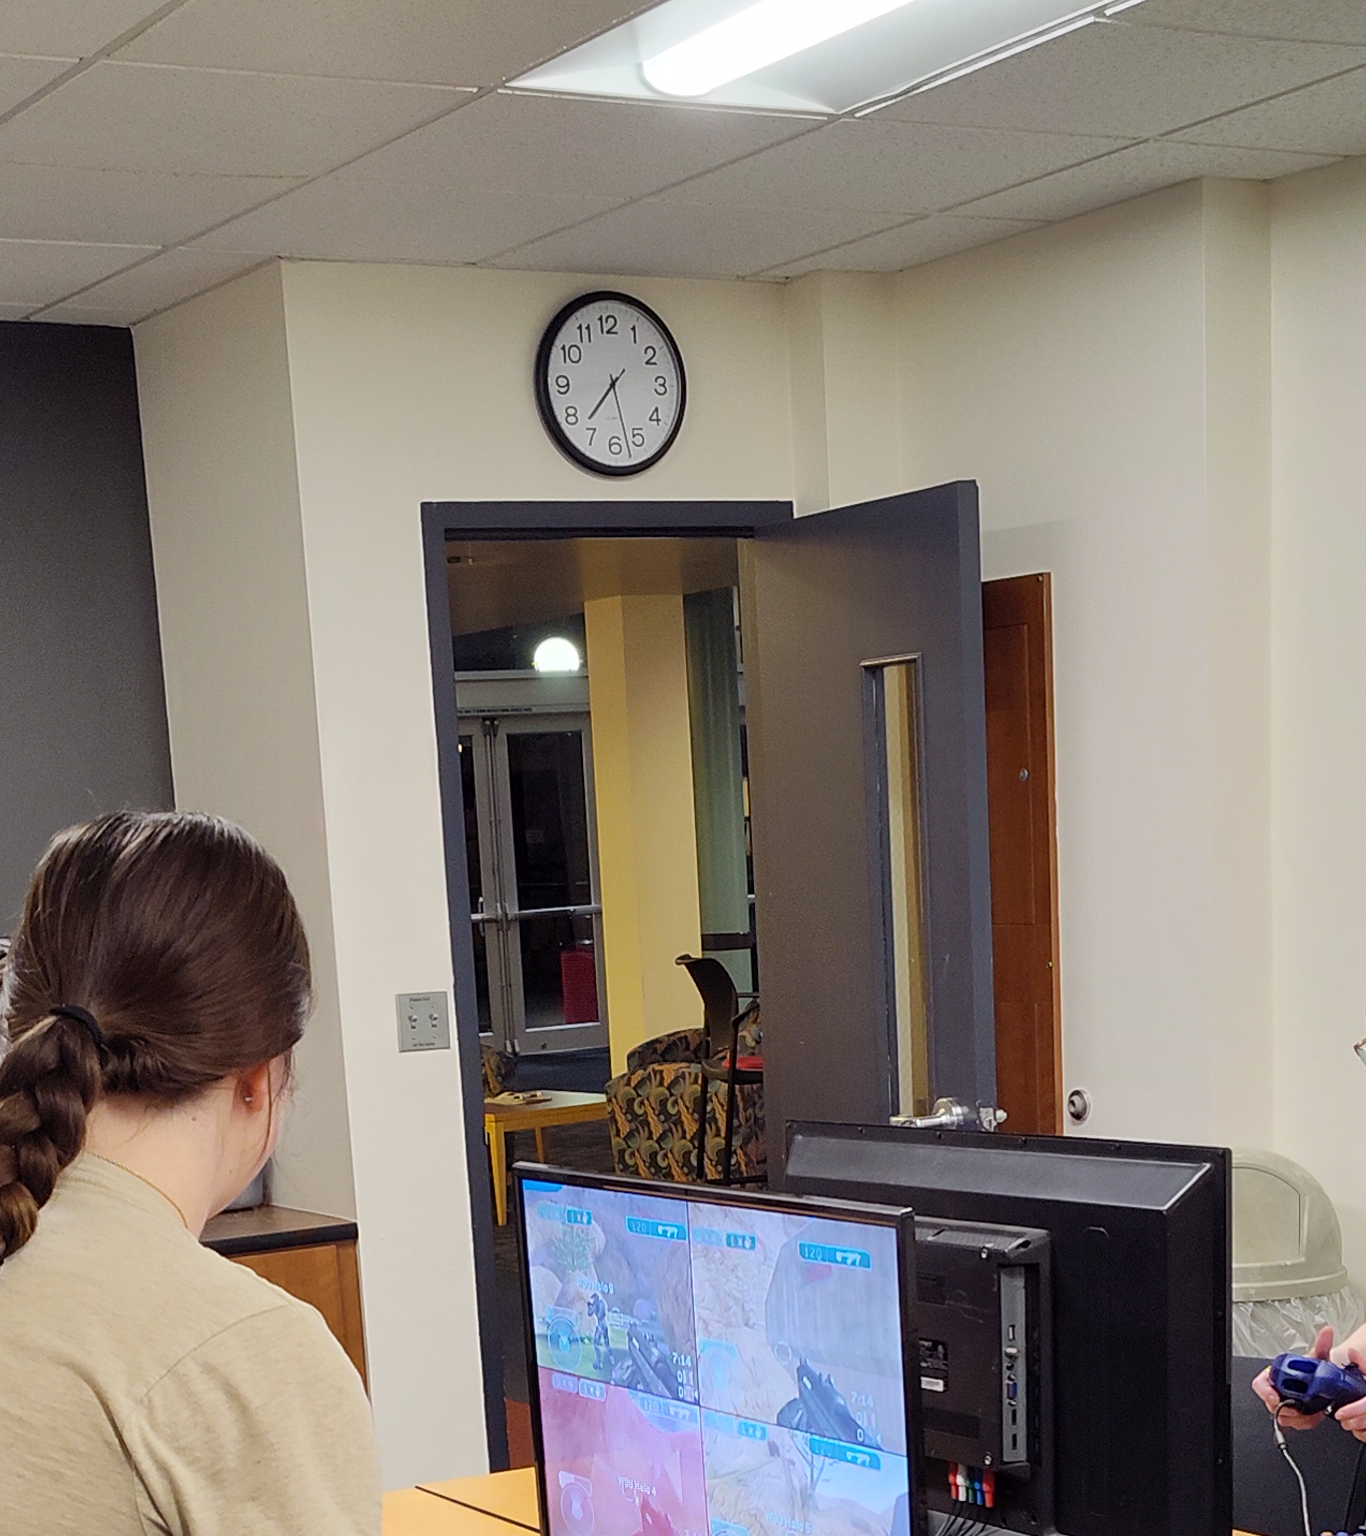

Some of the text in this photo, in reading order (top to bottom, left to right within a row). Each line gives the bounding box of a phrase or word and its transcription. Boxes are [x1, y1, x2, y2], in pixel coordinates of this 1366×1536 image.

[577, 323, 592, 343] 11
[598, 315, 618, 335] 12
[630, 325, 637, 344] 1
[560, 344, 582, 364] 10
[644, 346, 657, 365] 2
[555, 375, 570, 395] 9
[654, 376, 667, 396] 3
[565, 406, 579, 425] 8
[648, 407, 662, 426] 4
[585, 428, 597, 446] 7
[608, 436, 622, 456] 6
[631, 428, 645, 447] 5
[804, 1246, 822, 1261] 120
